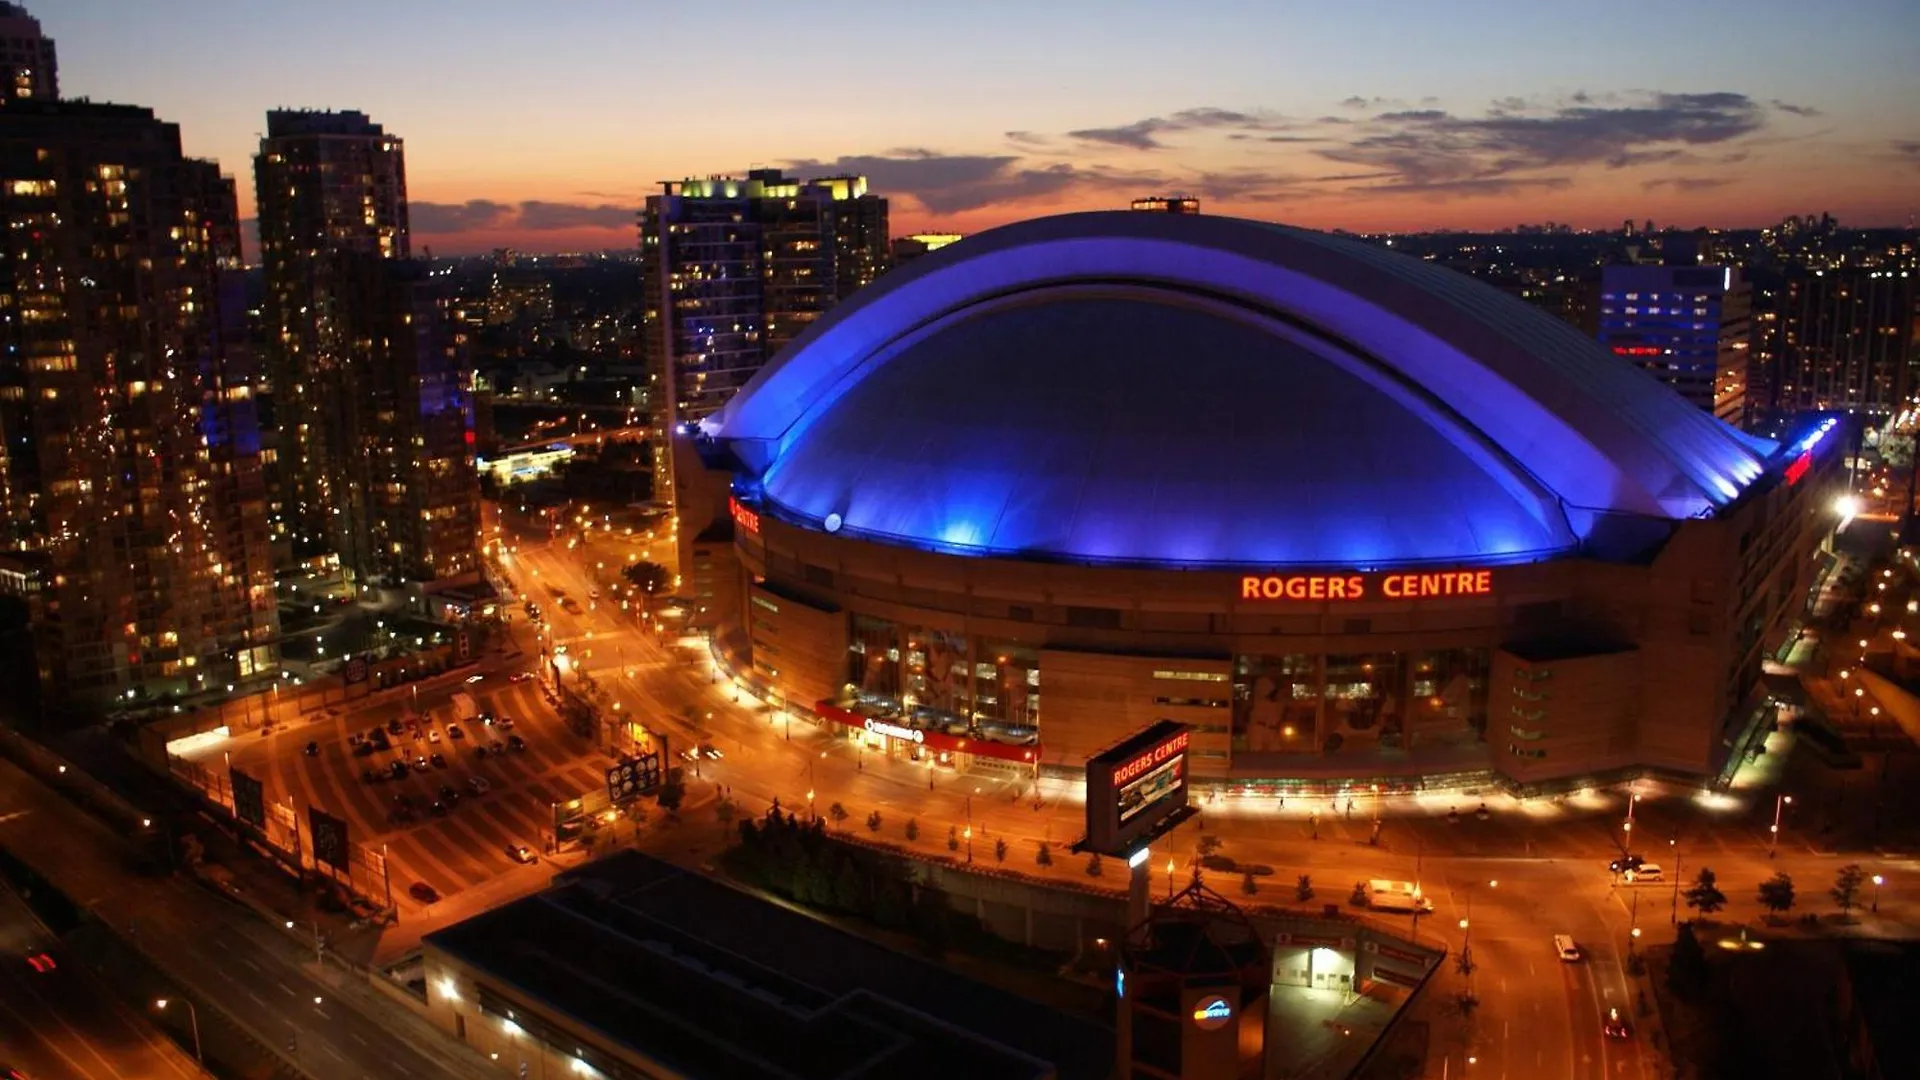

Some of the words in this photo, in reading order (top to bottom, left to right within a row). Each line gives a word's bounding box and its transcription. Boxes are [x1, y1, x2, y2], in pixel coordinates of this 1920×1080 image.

[1241, 576, 1364, 599] ROGERS
[1382, 571, 1492, 597] CENTRE
[1113, 753, 1153, 786] ROGERS
[1154, 732, 1189, 761] CENTRE
